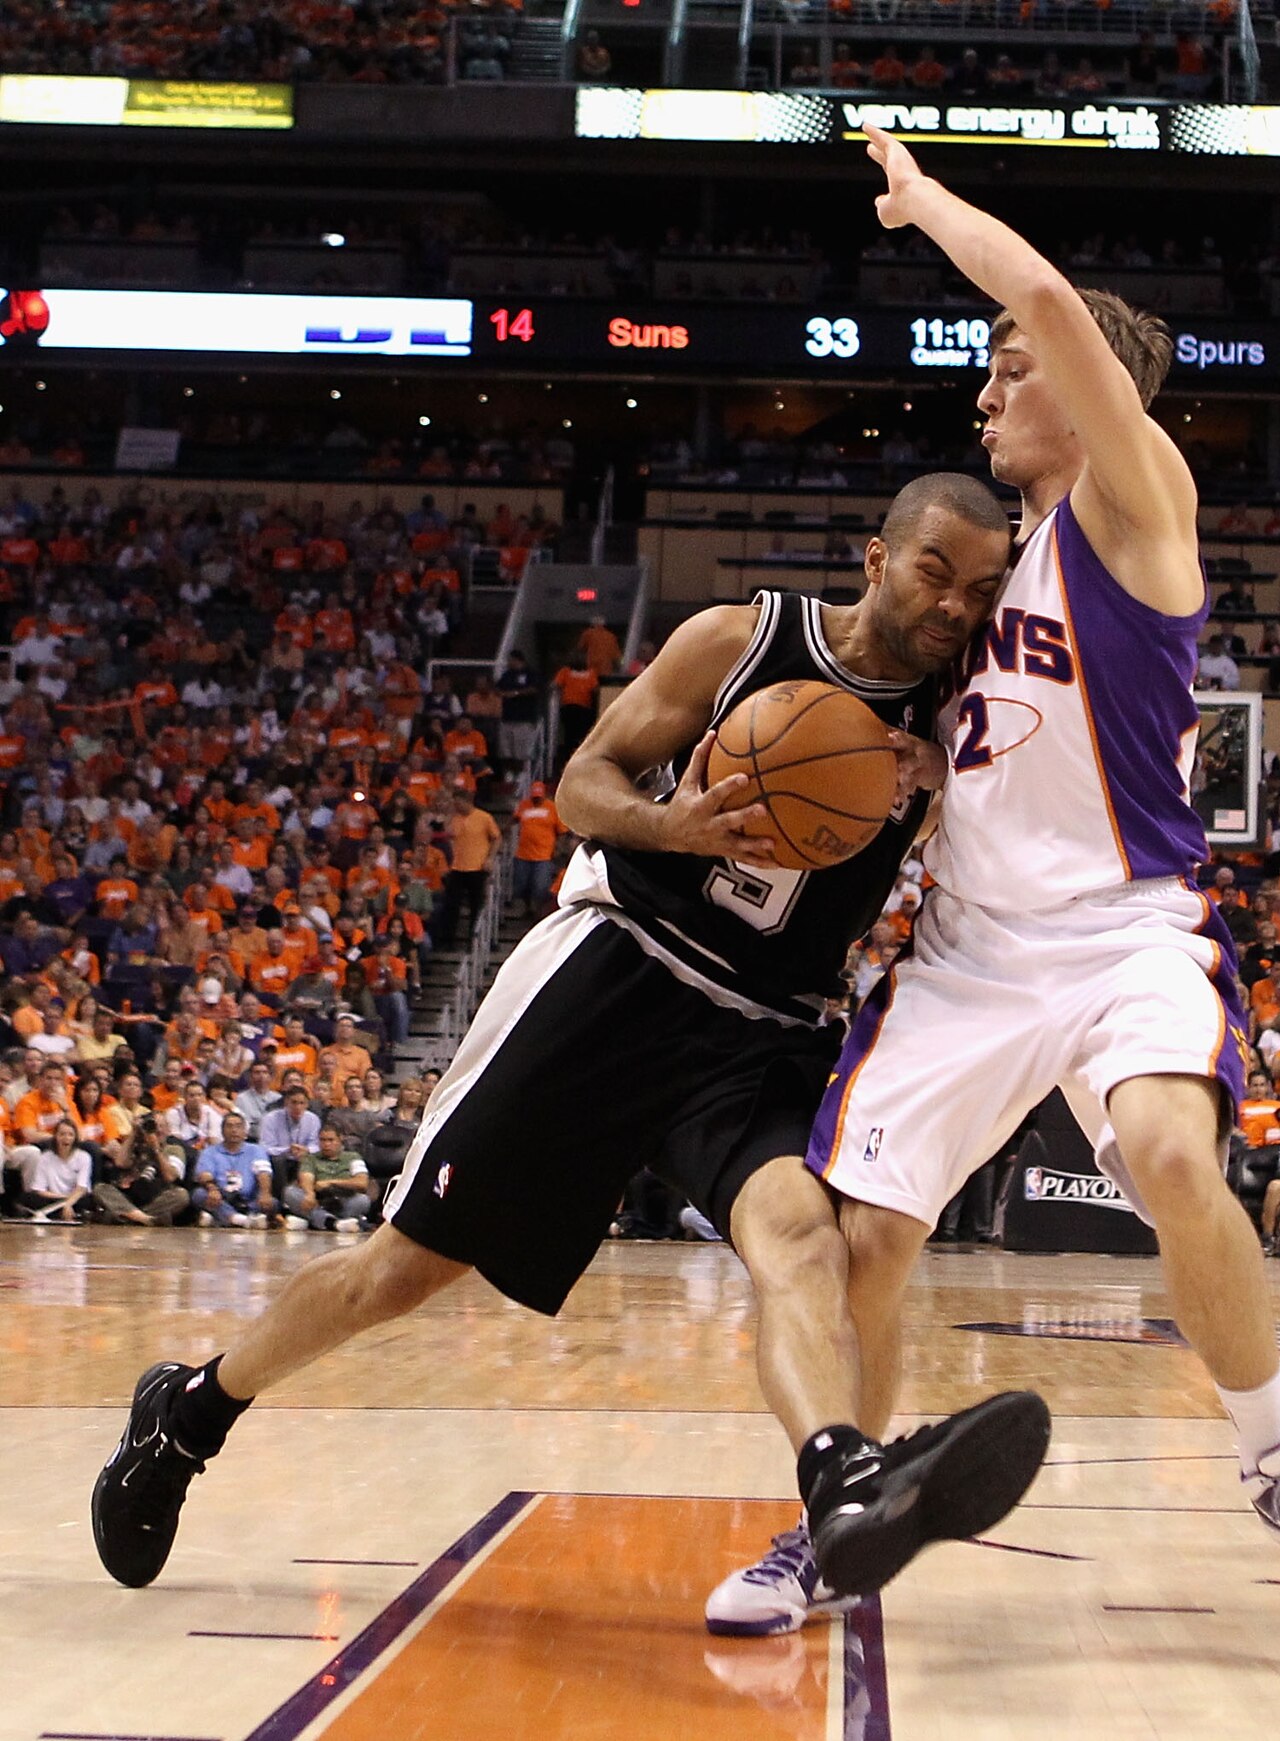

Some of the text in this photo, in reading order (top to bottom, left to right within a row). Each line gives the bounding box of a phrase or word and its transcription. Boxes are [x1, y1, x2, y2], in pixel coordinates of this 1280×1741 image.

[946, 106, 1066, 140] energy
[1071, 104, 1160, 136] drink
[490, 308, 535, 342] 14
[608, 317, 689, 349] Suns
[805, 317, 860, 357] 33
[910, 318, 990, 348] 11:10
[1176, 333, 1265, 369] Spurs
[960, 607, 1076, 688] NS
